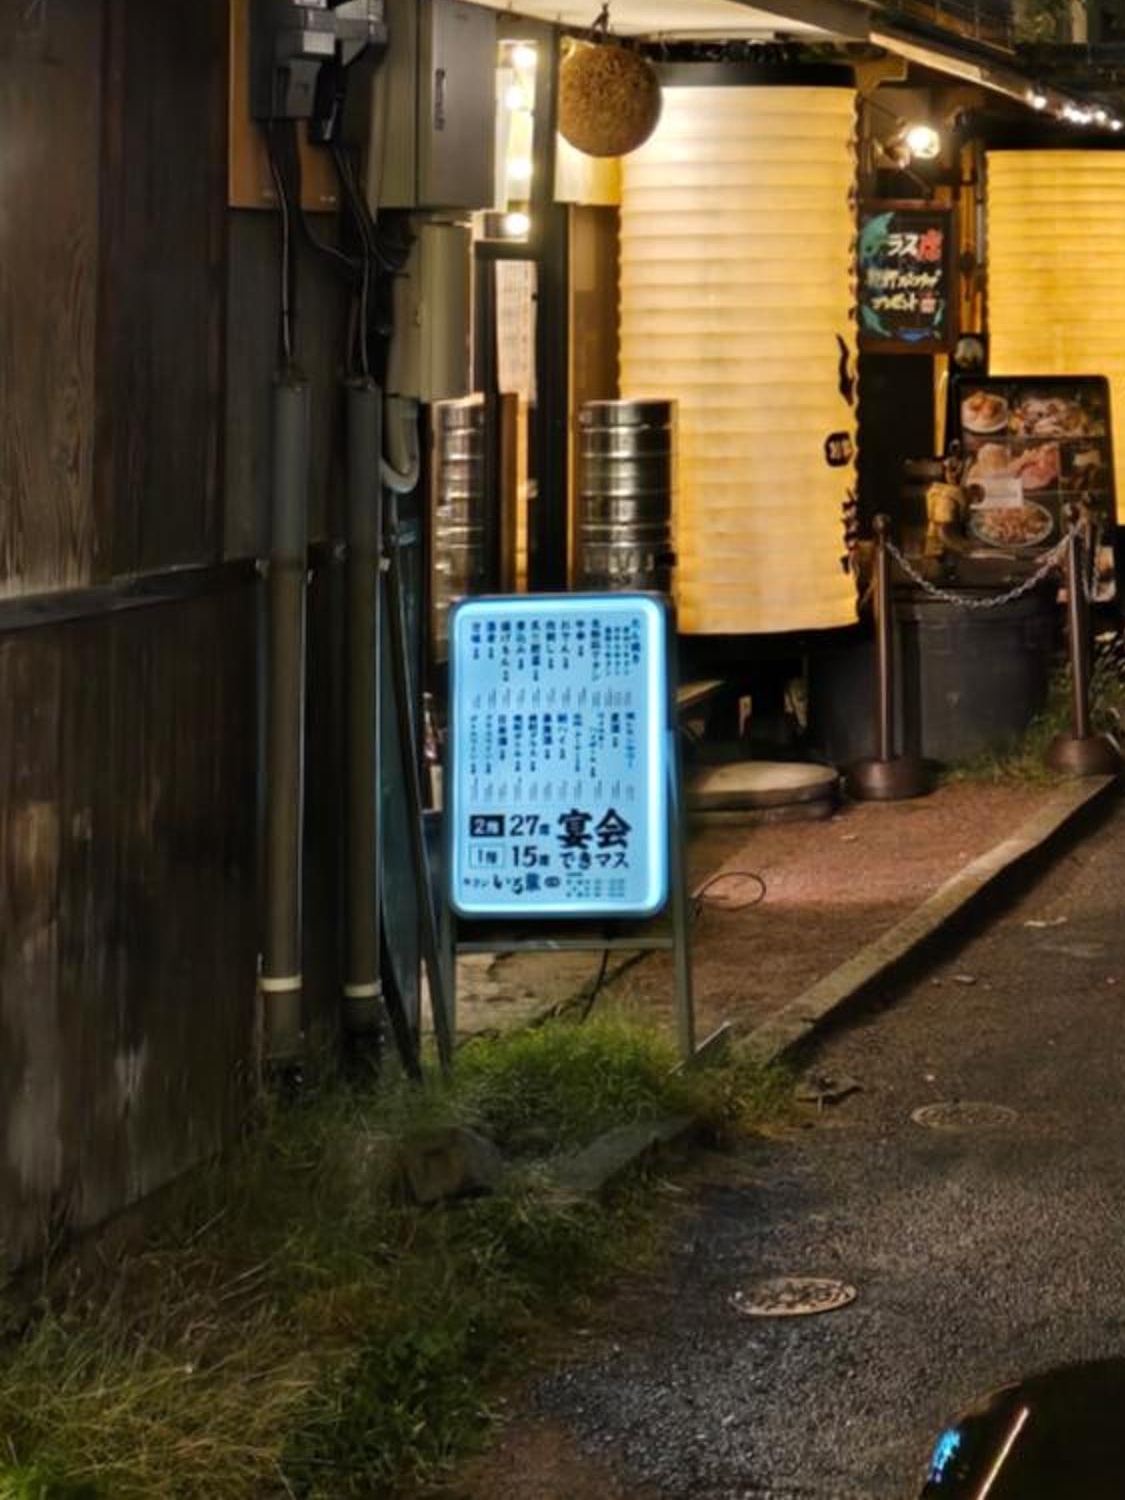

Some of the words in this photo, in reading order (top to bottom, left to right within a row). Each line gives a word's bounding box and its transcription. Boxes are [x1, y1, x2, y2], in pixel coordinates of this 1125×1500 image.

[556, 808, 632, 849] 宴会
[560, 852, 629, 869] できマス
